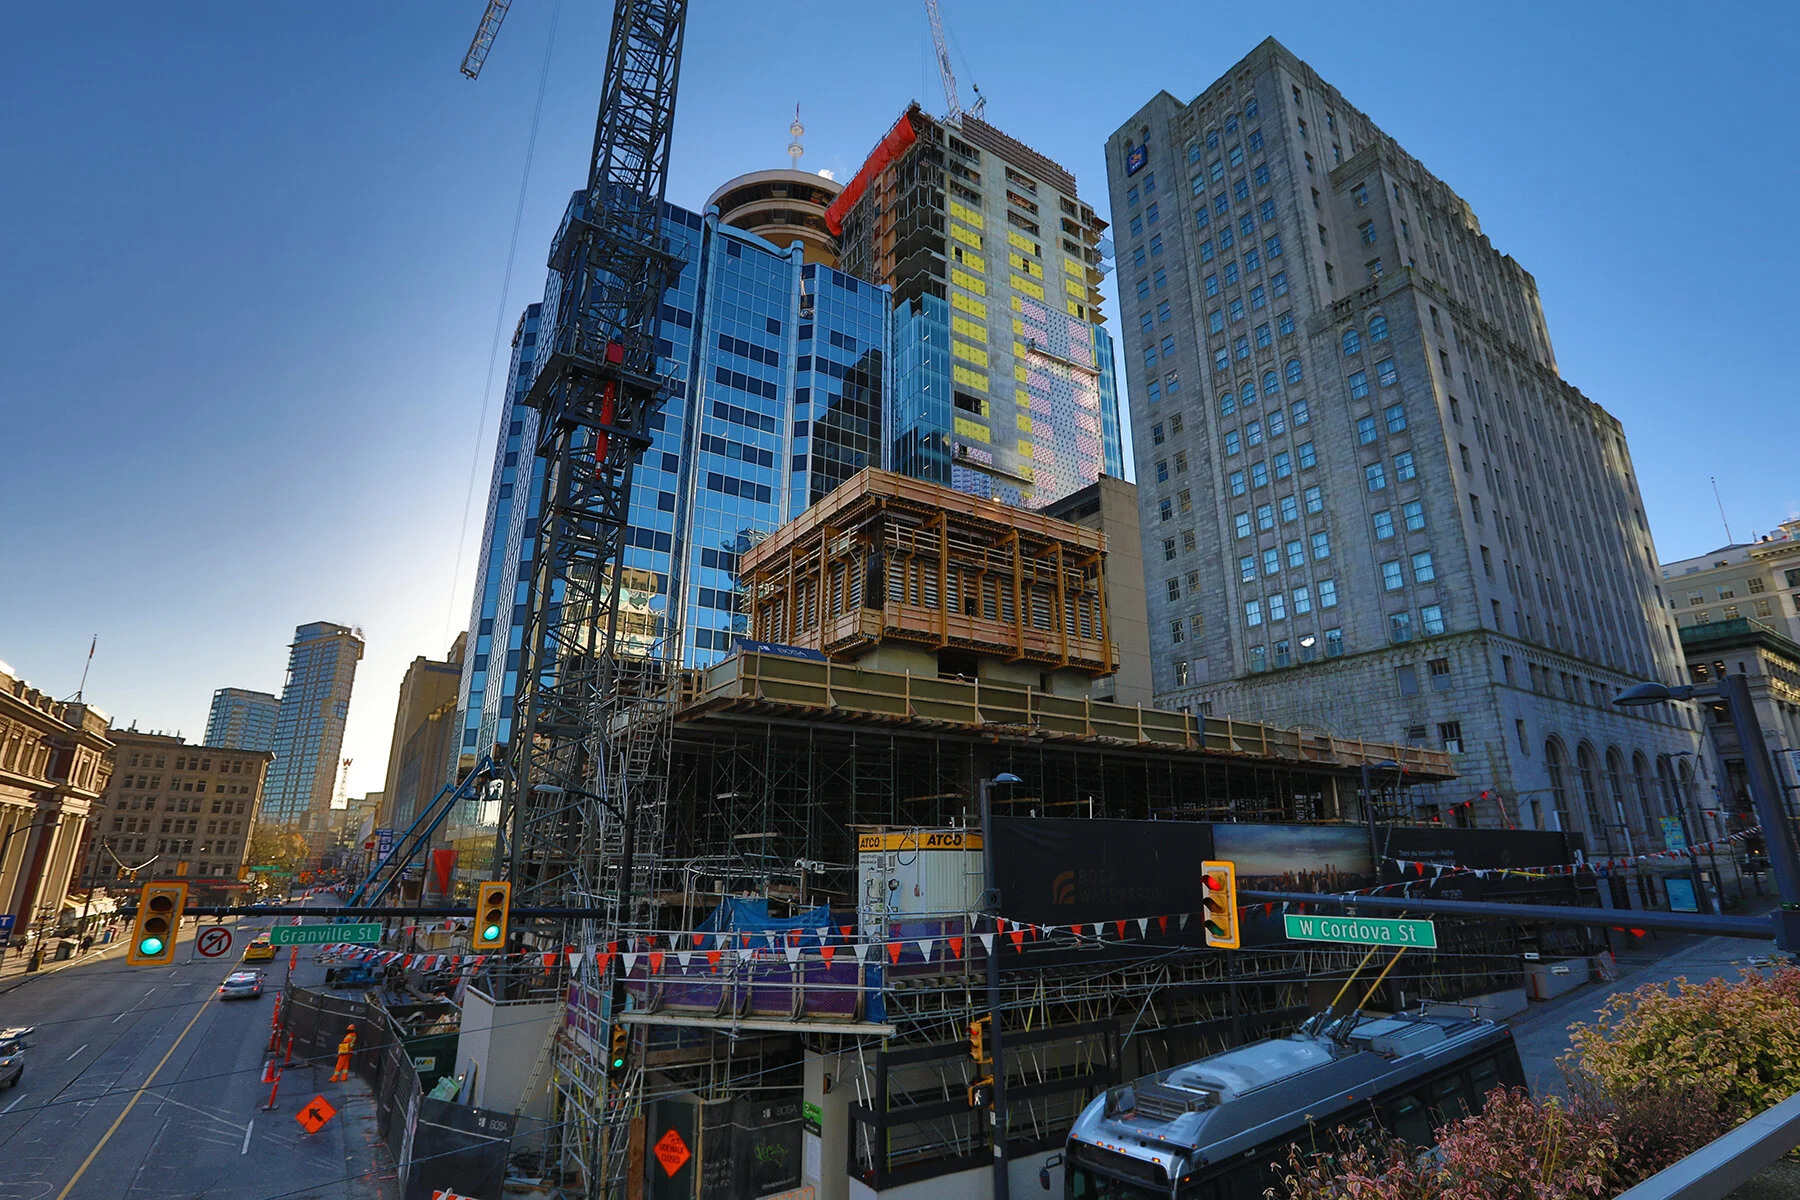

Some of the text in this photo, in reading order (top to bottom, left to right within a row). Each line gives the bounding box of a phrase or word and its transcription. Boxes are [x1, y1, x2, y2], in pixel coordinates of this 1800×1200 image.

[342, 757, 354, 767] W
[859, 836, 880, 849] ATCO
[926, 834, 964, 846] ATCO
[1078, 869, 1118, 884] BOSA
[280, 927, 372, 943] Granville St
[1299, 920, 1417, 942] W Cordova St
[776, 1105, 797, 1116] BOSA
[490, 1120, 507, 1131] BOSA
[659, 1143, 685, 1155] SIDEWALK
[661, 1154, 681, 1164] CLOSED
